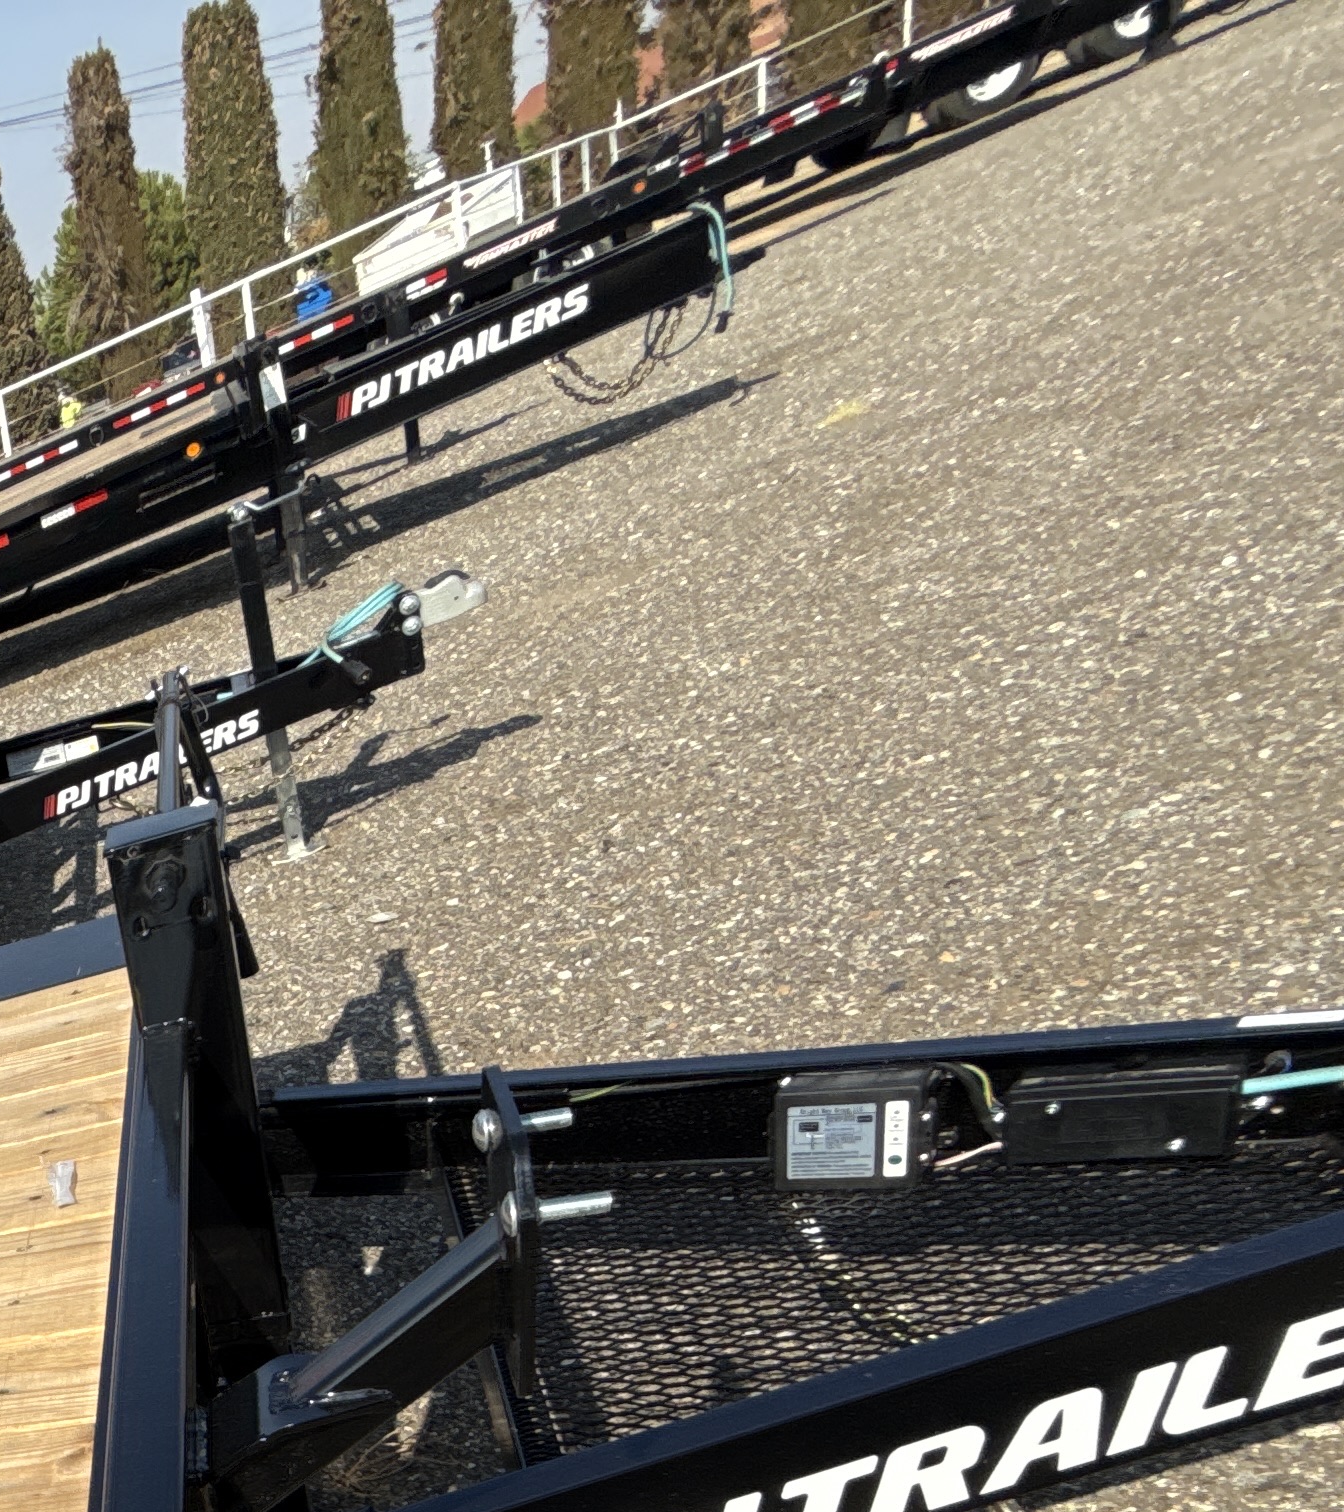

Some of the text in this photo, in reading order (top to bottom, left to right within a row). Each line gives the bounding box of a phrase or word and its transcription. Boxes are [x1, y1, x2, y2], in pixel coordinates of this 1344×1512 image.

[350, 283, 590, 417] PJ TRAILERS
[56, 779, 92, 815] PJ
